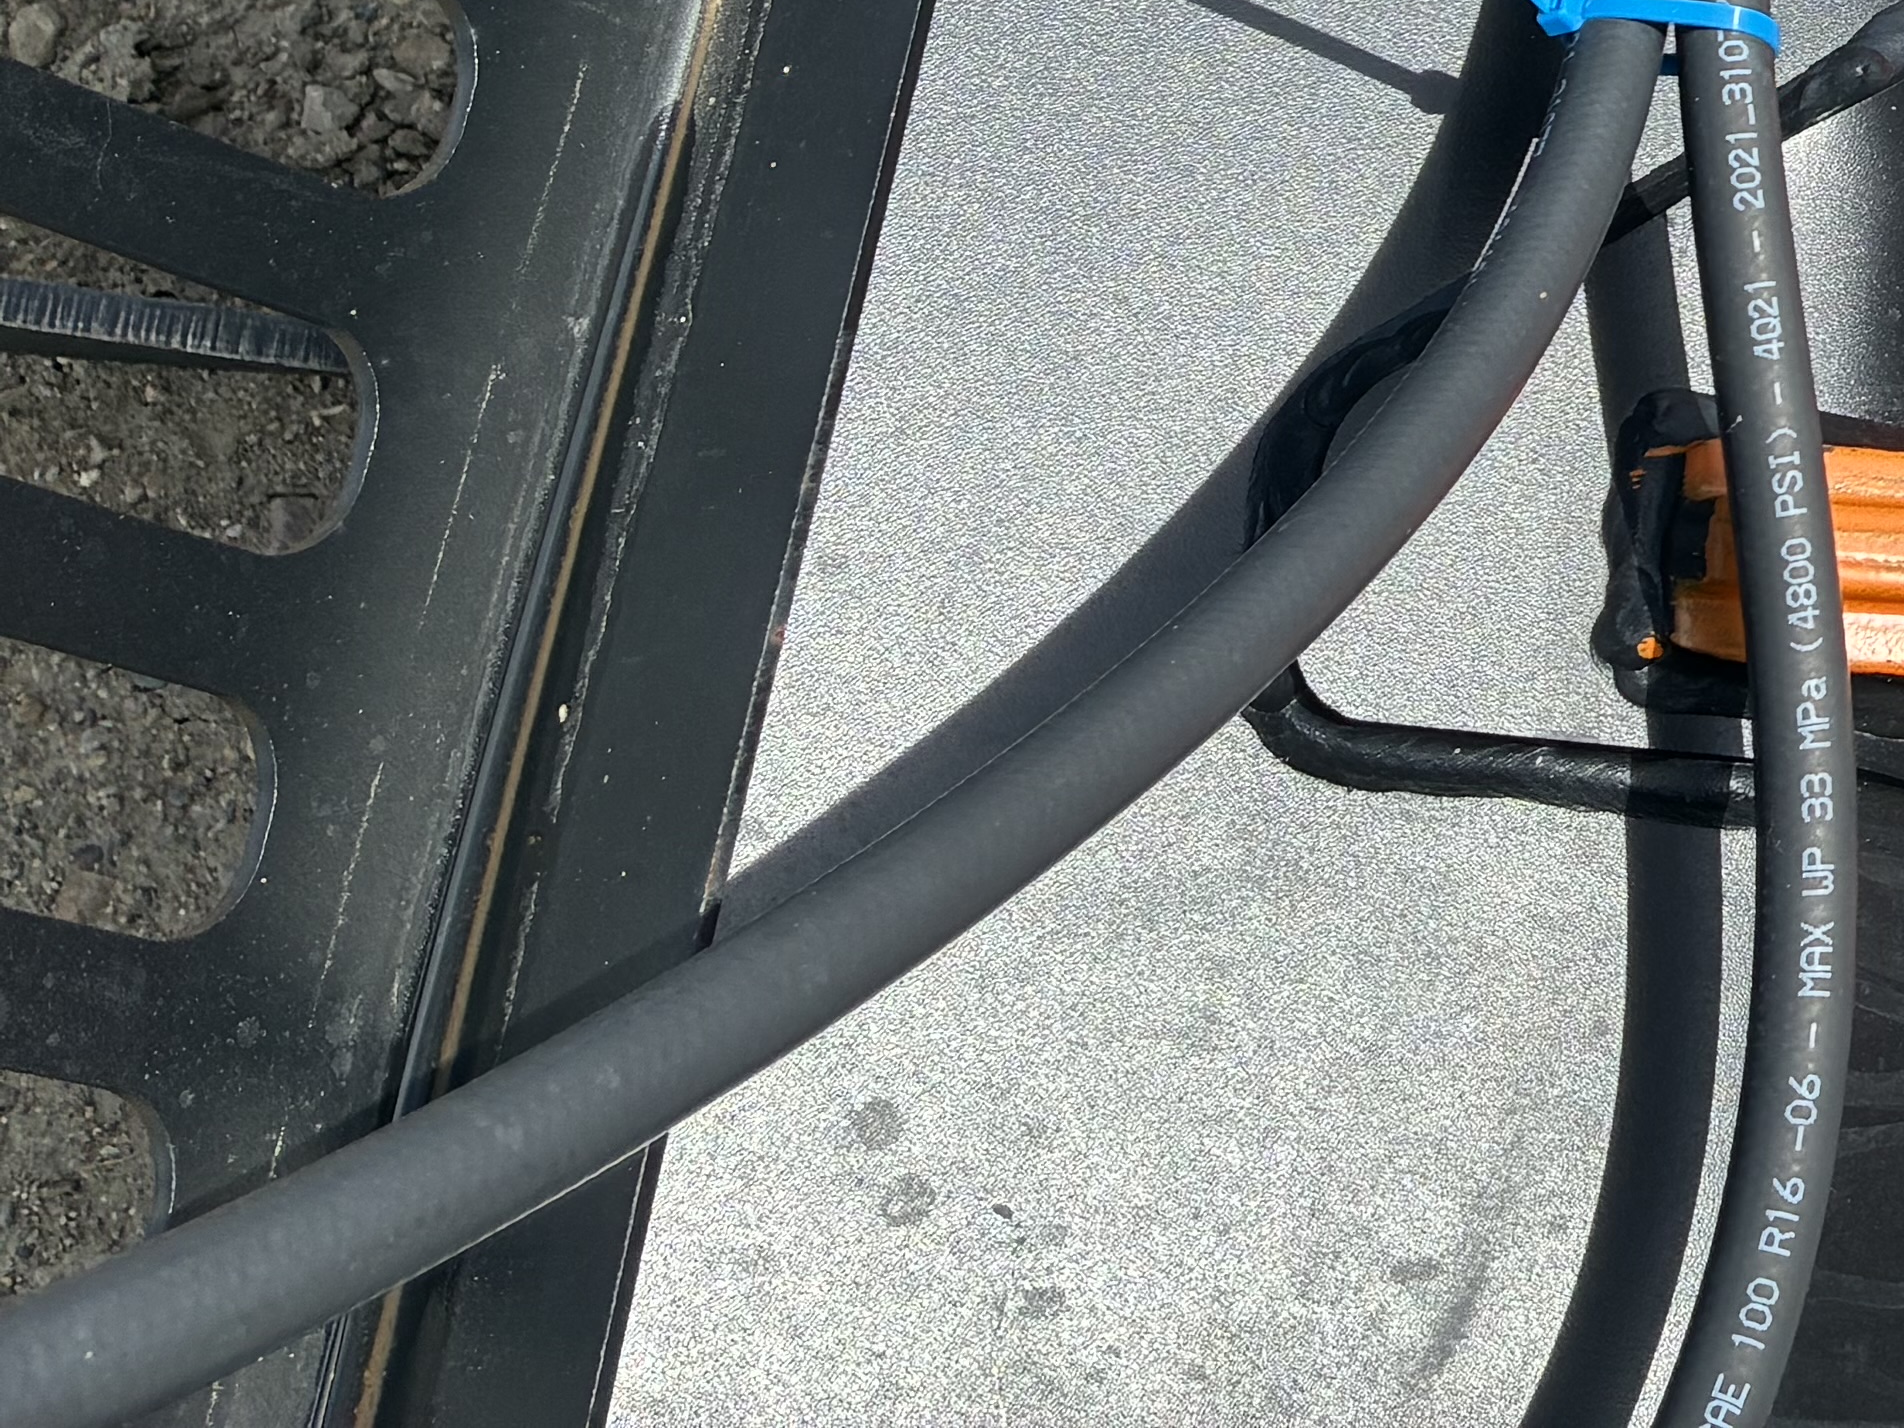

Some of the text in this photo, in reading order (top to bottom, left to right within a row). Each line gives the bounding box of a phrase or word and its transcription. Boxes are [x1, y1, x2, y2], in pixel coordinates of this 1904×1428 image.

[1743, 280, 1785, 361] 4Q21
[1765, 422, 1808, 518] PSI)
[1780, 537, 1824, 652] (4800
[1795, 676, 1832, 751] MPa
[1800, 771, 1834, 824] 33
[1801, 847, 1835, 897] WP
[1797, 922, 1835, 998] MAX
[1757, 1176, 1806, 1257] R16
[1731, 1276, 1780, 1351] 100
